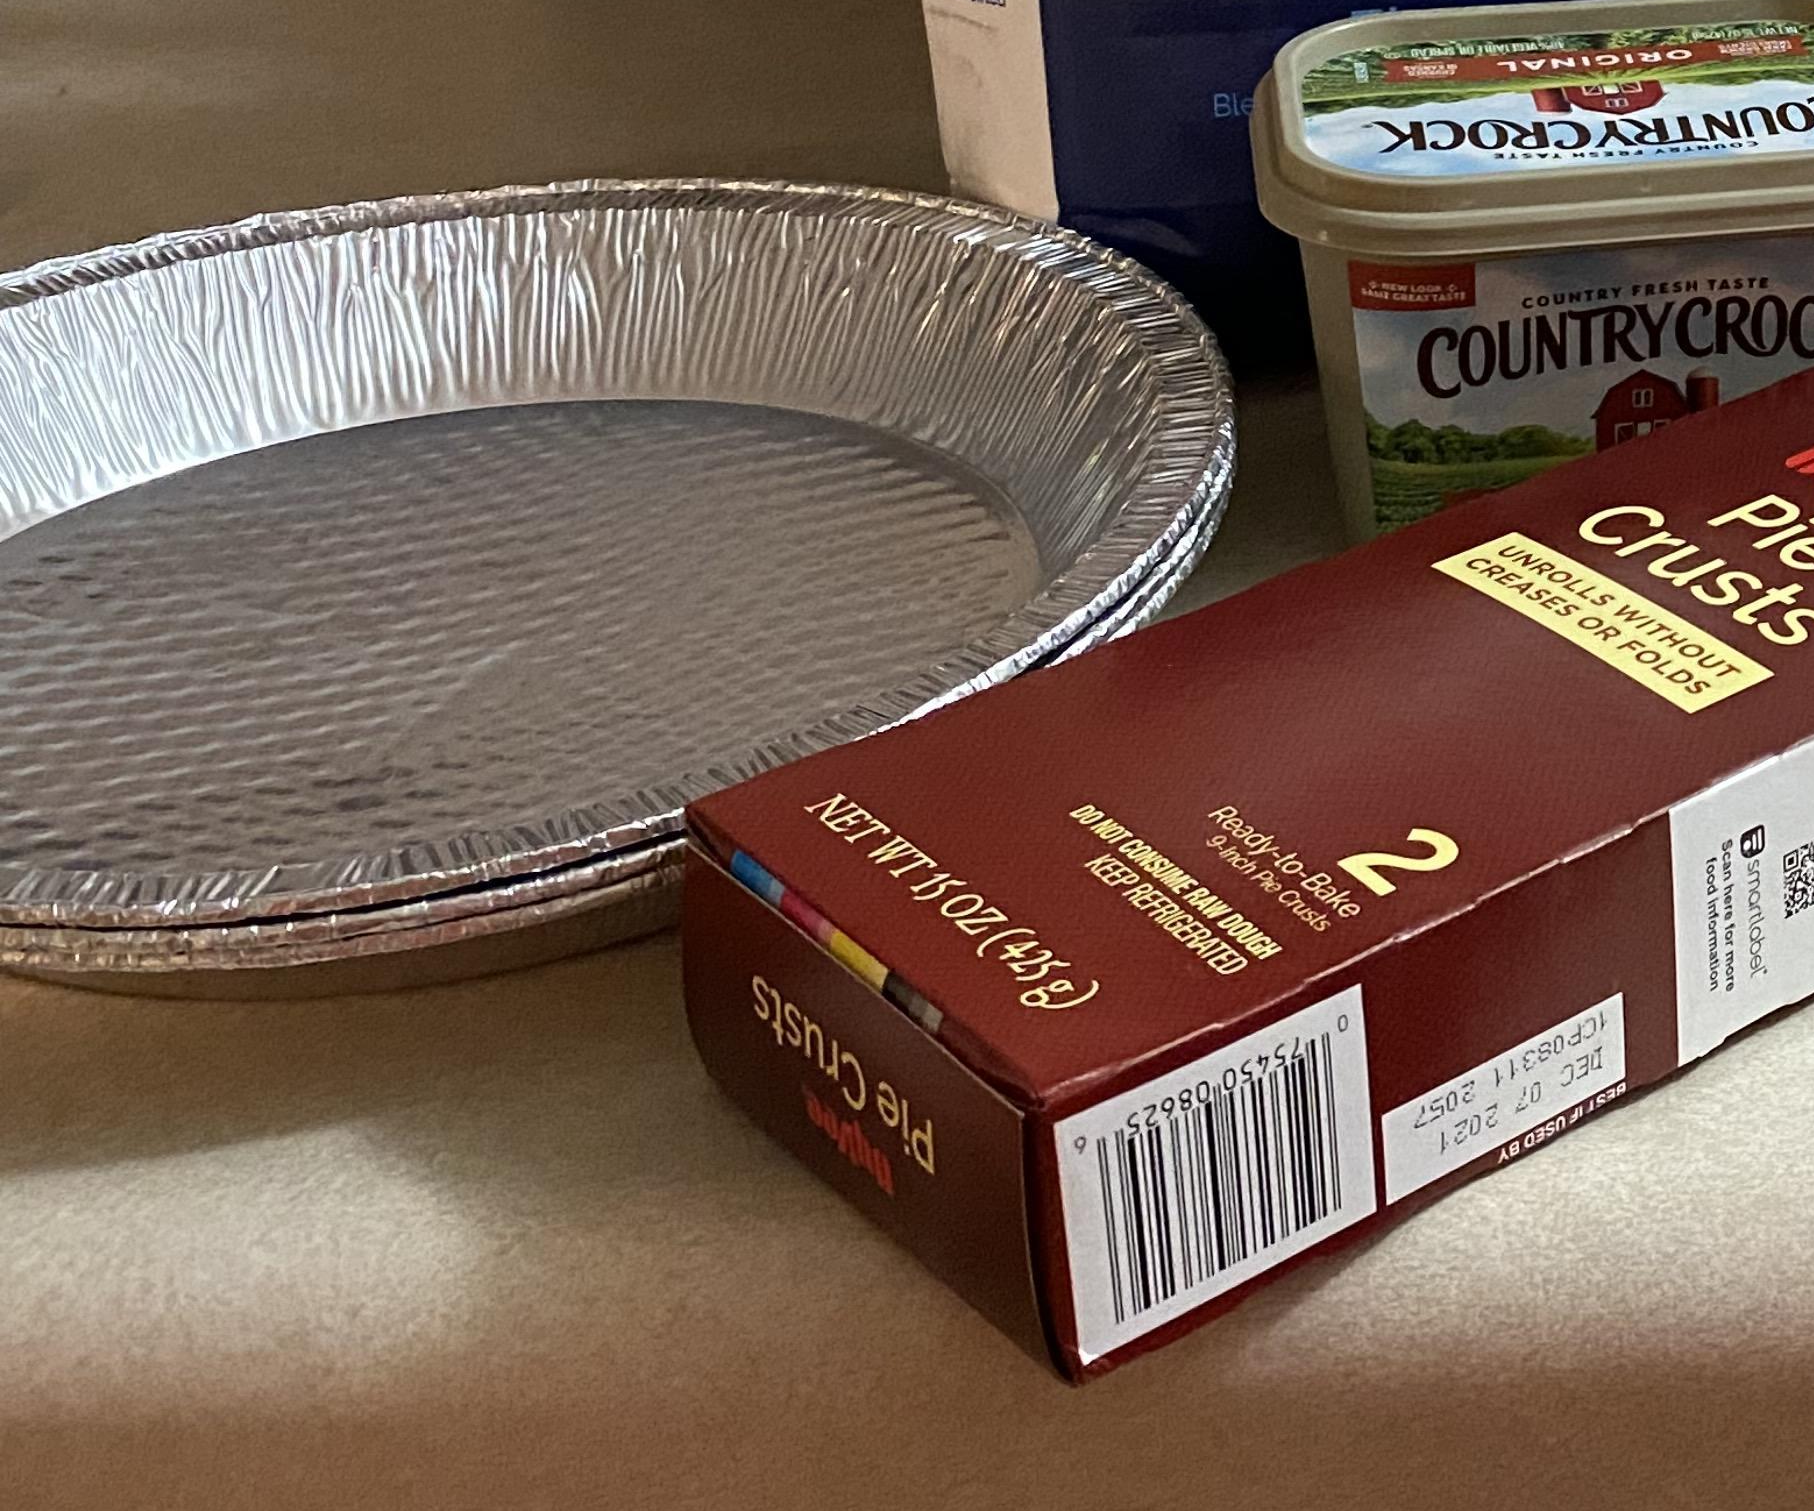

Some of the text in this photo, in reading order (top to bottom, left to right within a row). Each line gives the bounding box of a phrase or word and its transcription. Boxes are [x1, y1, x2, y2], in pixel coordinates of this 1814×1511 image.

[1496, 49, 1693, 73] ORIGINAL
[1655, 139, 1760, 156] COUNTRY
[1521, 276, 1770, 310] COUNTRY FRESH TASTE
[1465, 557, 1712, 695] CREASES OR FOLDS
[1498, 545, 1742, 678] UNROLLS WITHOUT
[803, 793, 891, 844] NET
[867, 835, 938, 878] WT
[910, 872, 969, 901] 15
[940, 893, 1010, 936] OZ
[1069, 804, 1283, 960] DO NOT CONSUME RAW DOUGH
[1084, 852, 1249, 976] KEEP REFRIGERATED
[1208, 806, 1362, 919] Ready-to-Bake
[1250, 868, 1283, 894] Pie
[1279, 890, 1332, 933] Crusts
[1336, 827, 1460, 897] 2
[1721, 838, 1735, 993] Scan here for more
[1705, 855, 1720, 992] food information
[752, 975, 936, 1176] Pie Crusts
[1413, 1079, 1476, 1130] 2057
[1439, 1046, 1604, 1156] DEC 07 2021
[1497, 1082, 1627, 1165] BEST IF USED BY
